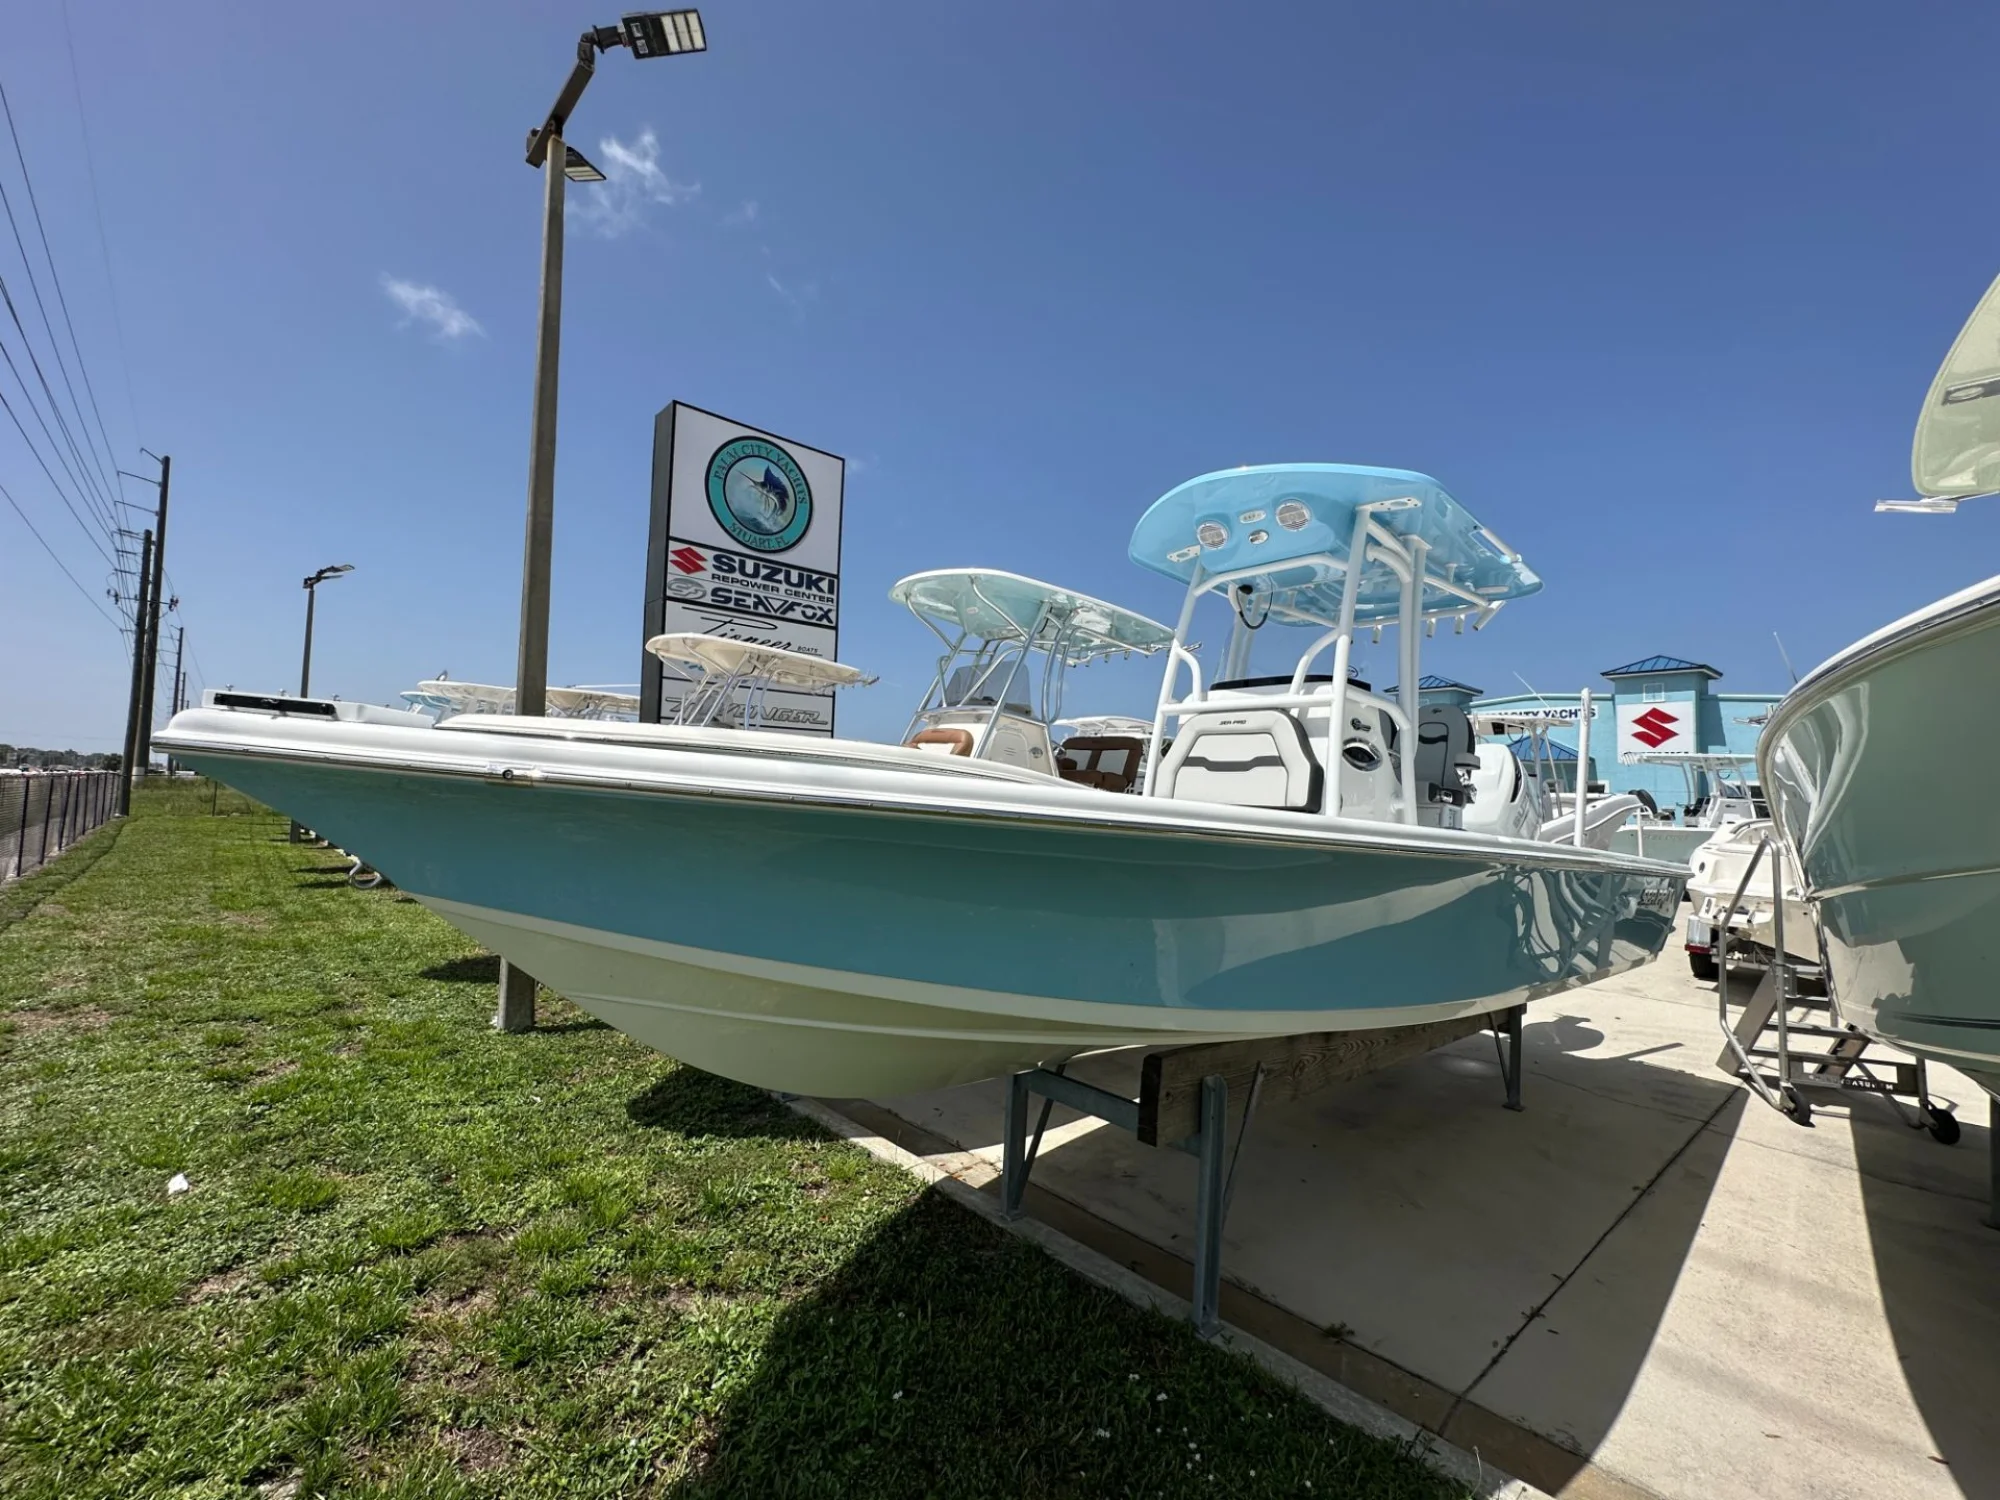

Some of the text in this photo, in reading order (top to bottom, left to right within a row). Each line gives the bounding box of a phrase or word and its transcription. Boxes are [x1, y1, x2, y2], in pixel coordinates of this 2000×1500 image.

[713, 443, 808, 505] PALM CITY YACHTS
[775, 535, 790, 548] FL
[711, 573, 834, 604] REPOWER CENTER
[712, 553, 836, 596] SUZUKI
